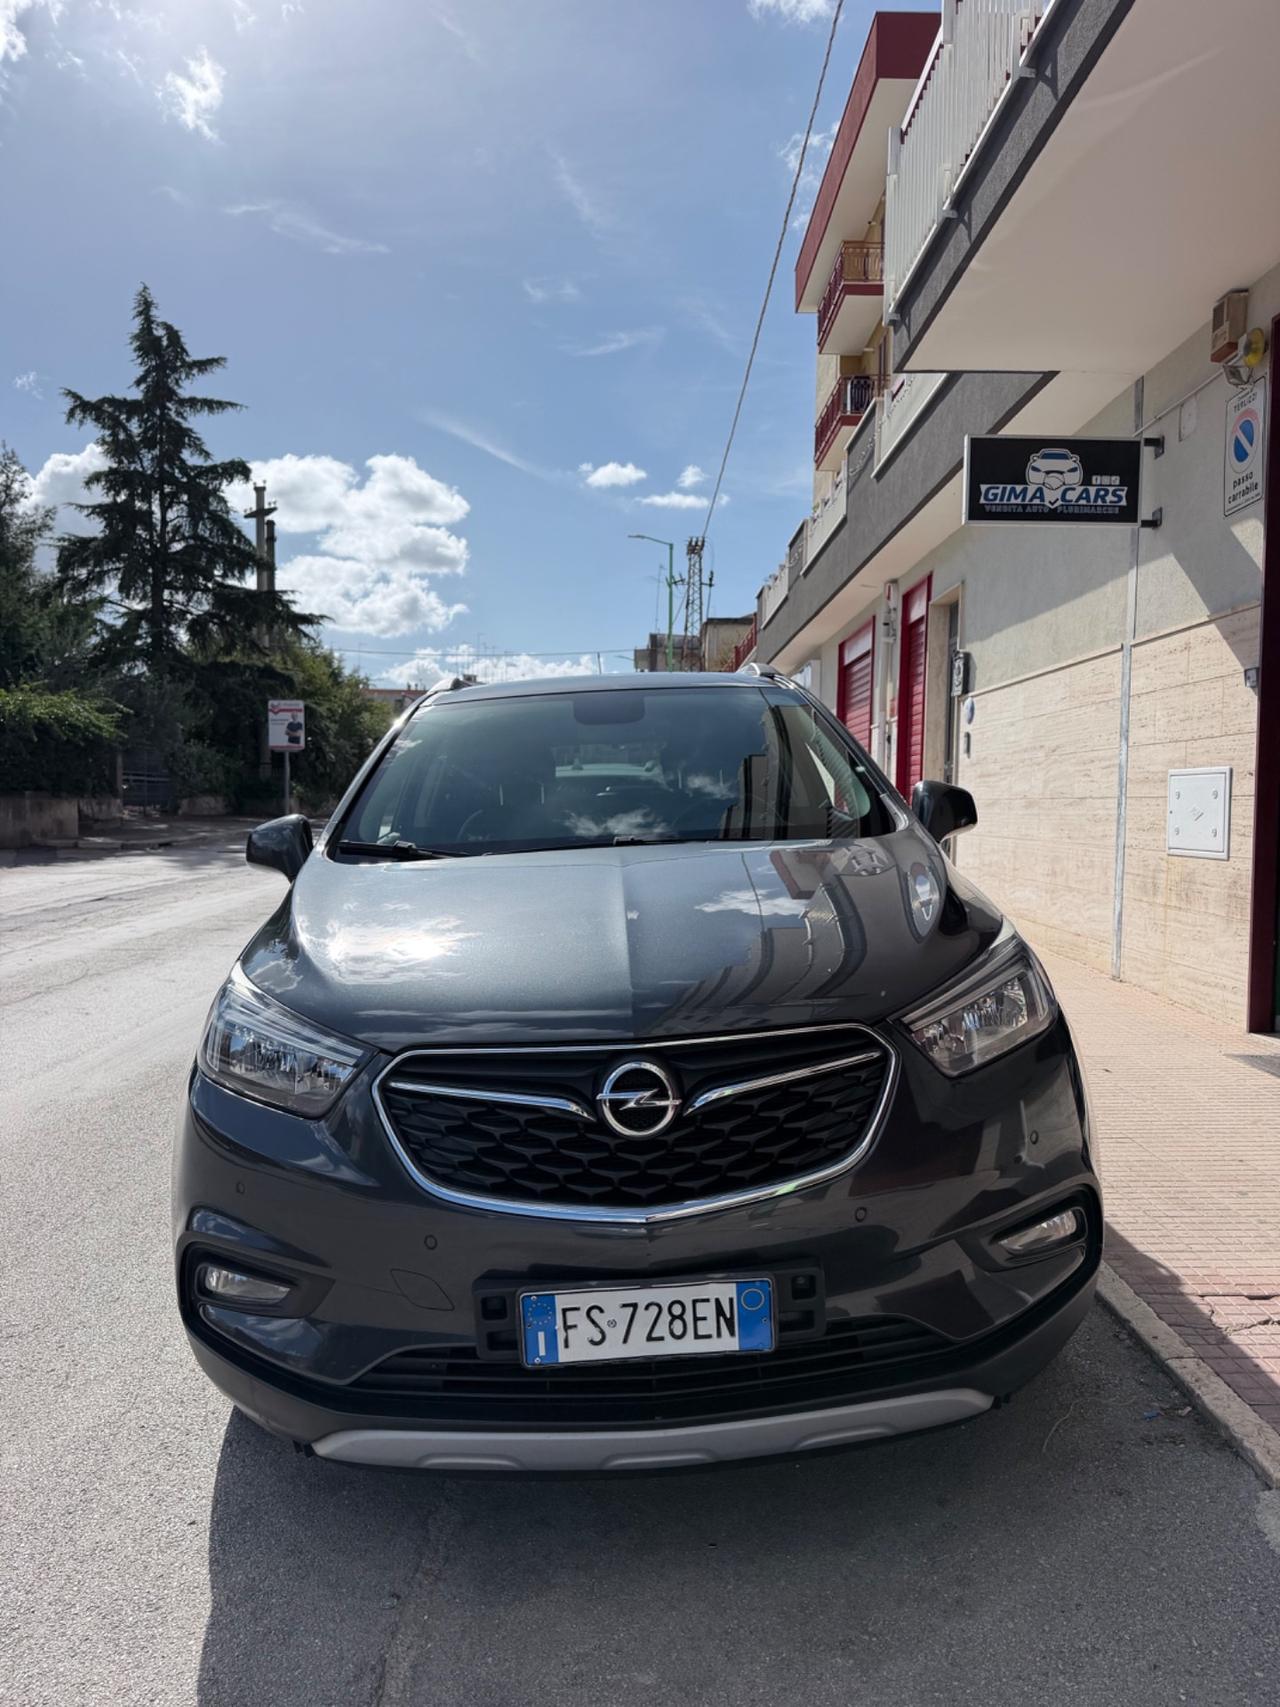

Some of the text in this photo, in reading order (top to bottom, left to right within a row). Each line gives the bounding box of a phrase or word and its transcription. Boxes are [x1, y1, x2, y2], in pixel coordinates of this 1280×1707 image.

[1232, 471, 1253, 490] passo
[983, 486, 1126, 505] GIMA CARS
[1228, 482, 1258, 504] carrabile
[984, 504, 1023, 513] VENDITA
[1025, 505, 1050, 513] AUTO
